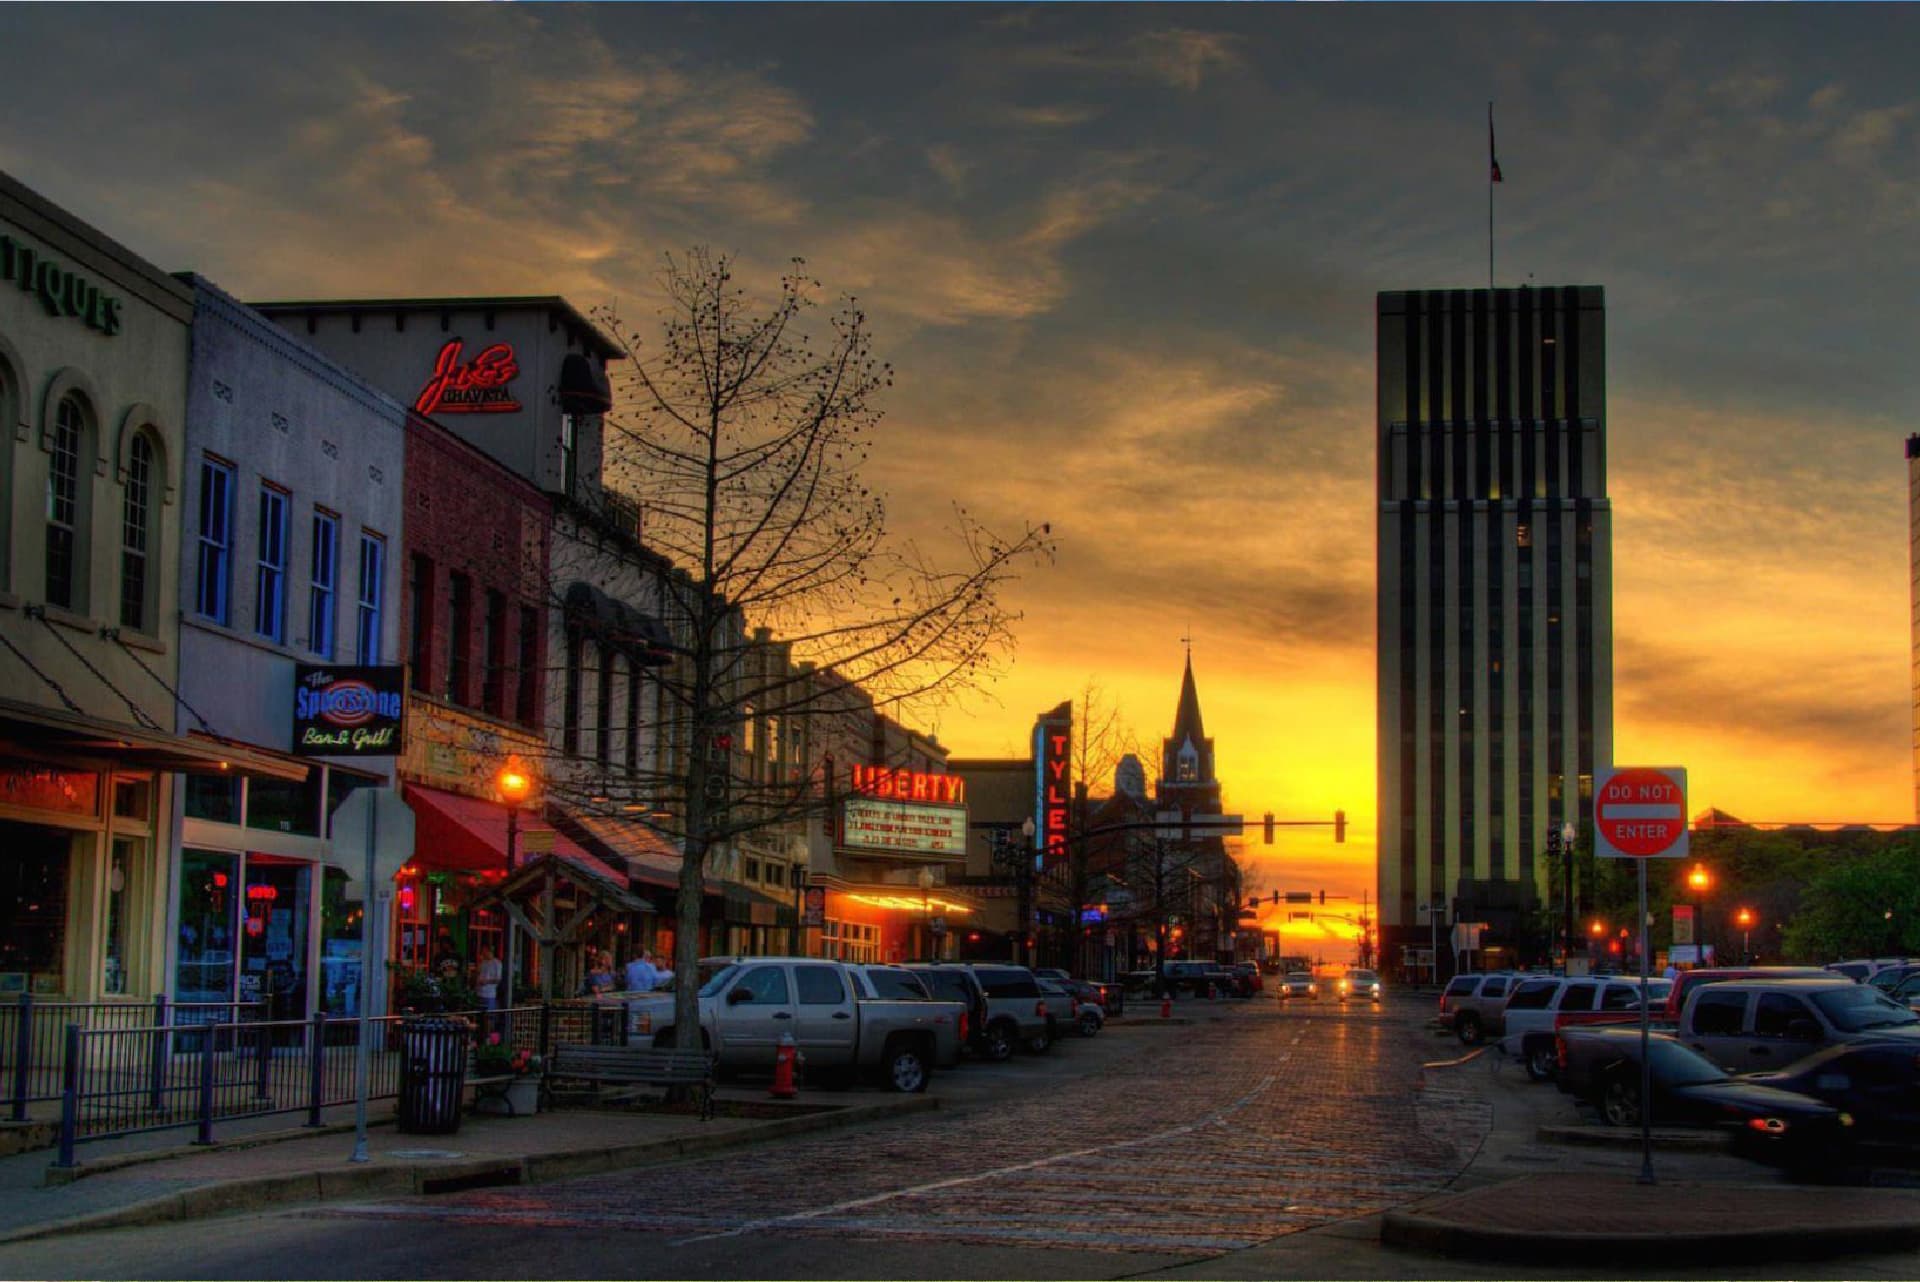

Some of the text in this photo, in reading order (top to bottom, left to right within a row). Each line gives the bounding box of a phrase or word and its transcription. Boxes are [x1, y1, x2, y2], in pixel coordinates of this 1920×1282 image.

[302, 727, 334, 745] Bar
[351, 727, 394, 751] Grill
[853, 763, 962, 805] LIBERTY
[1047, 735, 1068, 856] TYLER
[1608, 783, 1673, 801] DO NOT
[1616, 824, 1668, 839] ENTER
